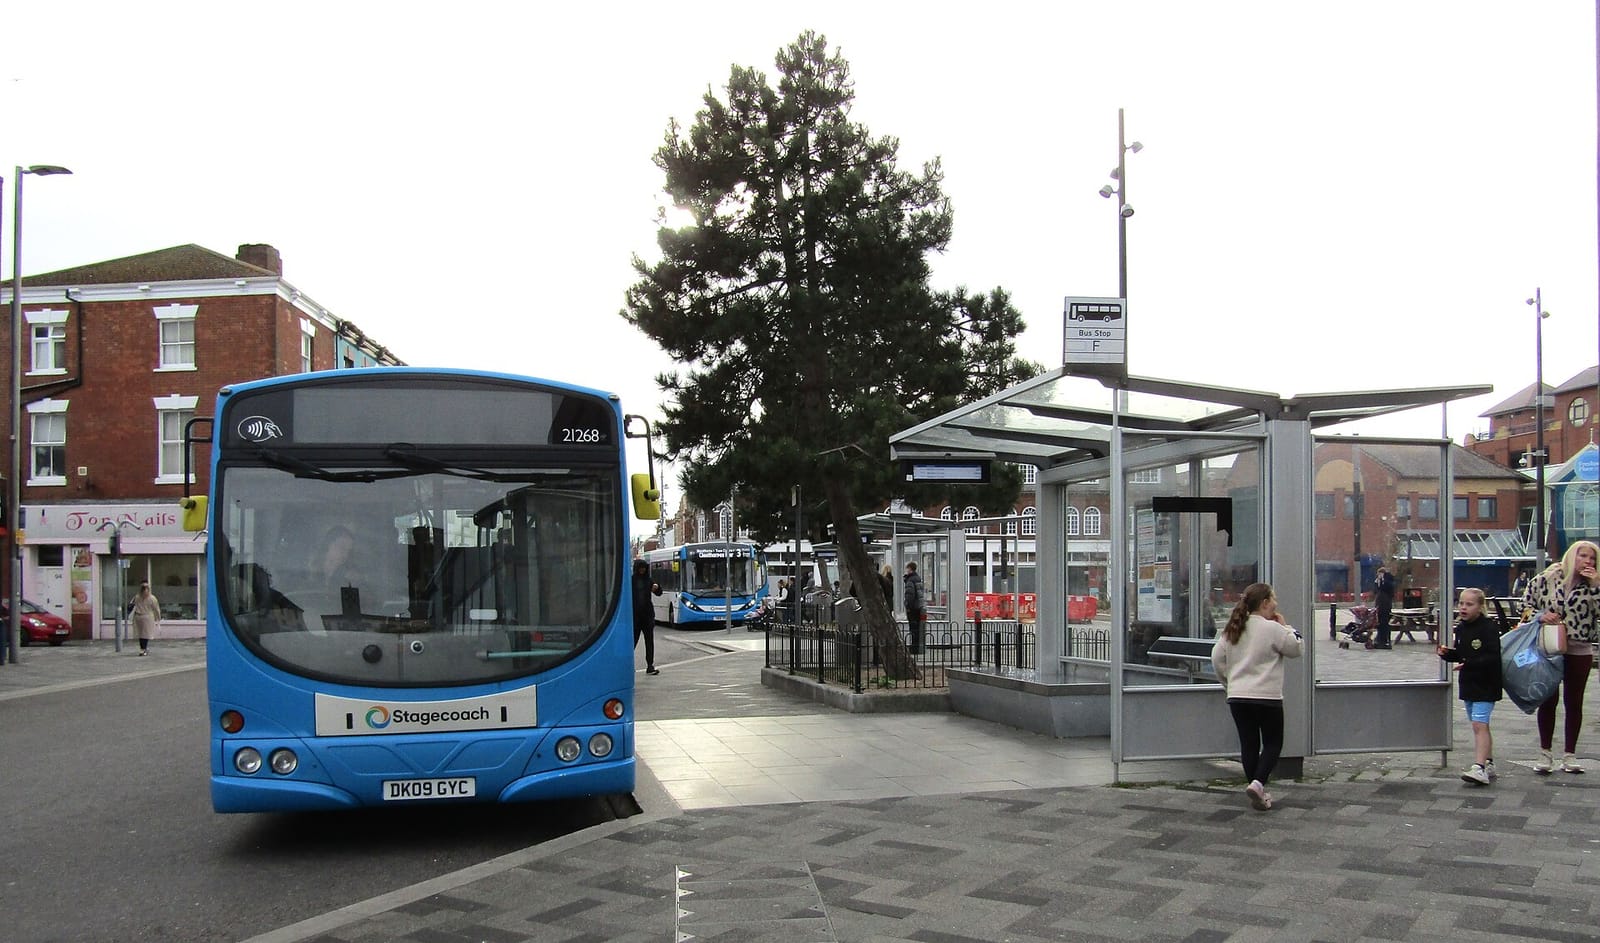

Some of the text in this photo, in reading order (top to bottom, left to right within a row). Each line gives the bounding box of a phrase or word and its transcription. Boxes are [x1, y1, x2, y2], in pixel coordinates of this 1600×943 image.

[1092, 340, 1101, 351] F
[562, 428, 600, 443] 21268
[66, 512, 176, 531] Top Nails
[736, 549, 741, 557] 3
[392, 706, 490, 726] Stagecoach
[389, 779, 469, 798] DK09 GYC
